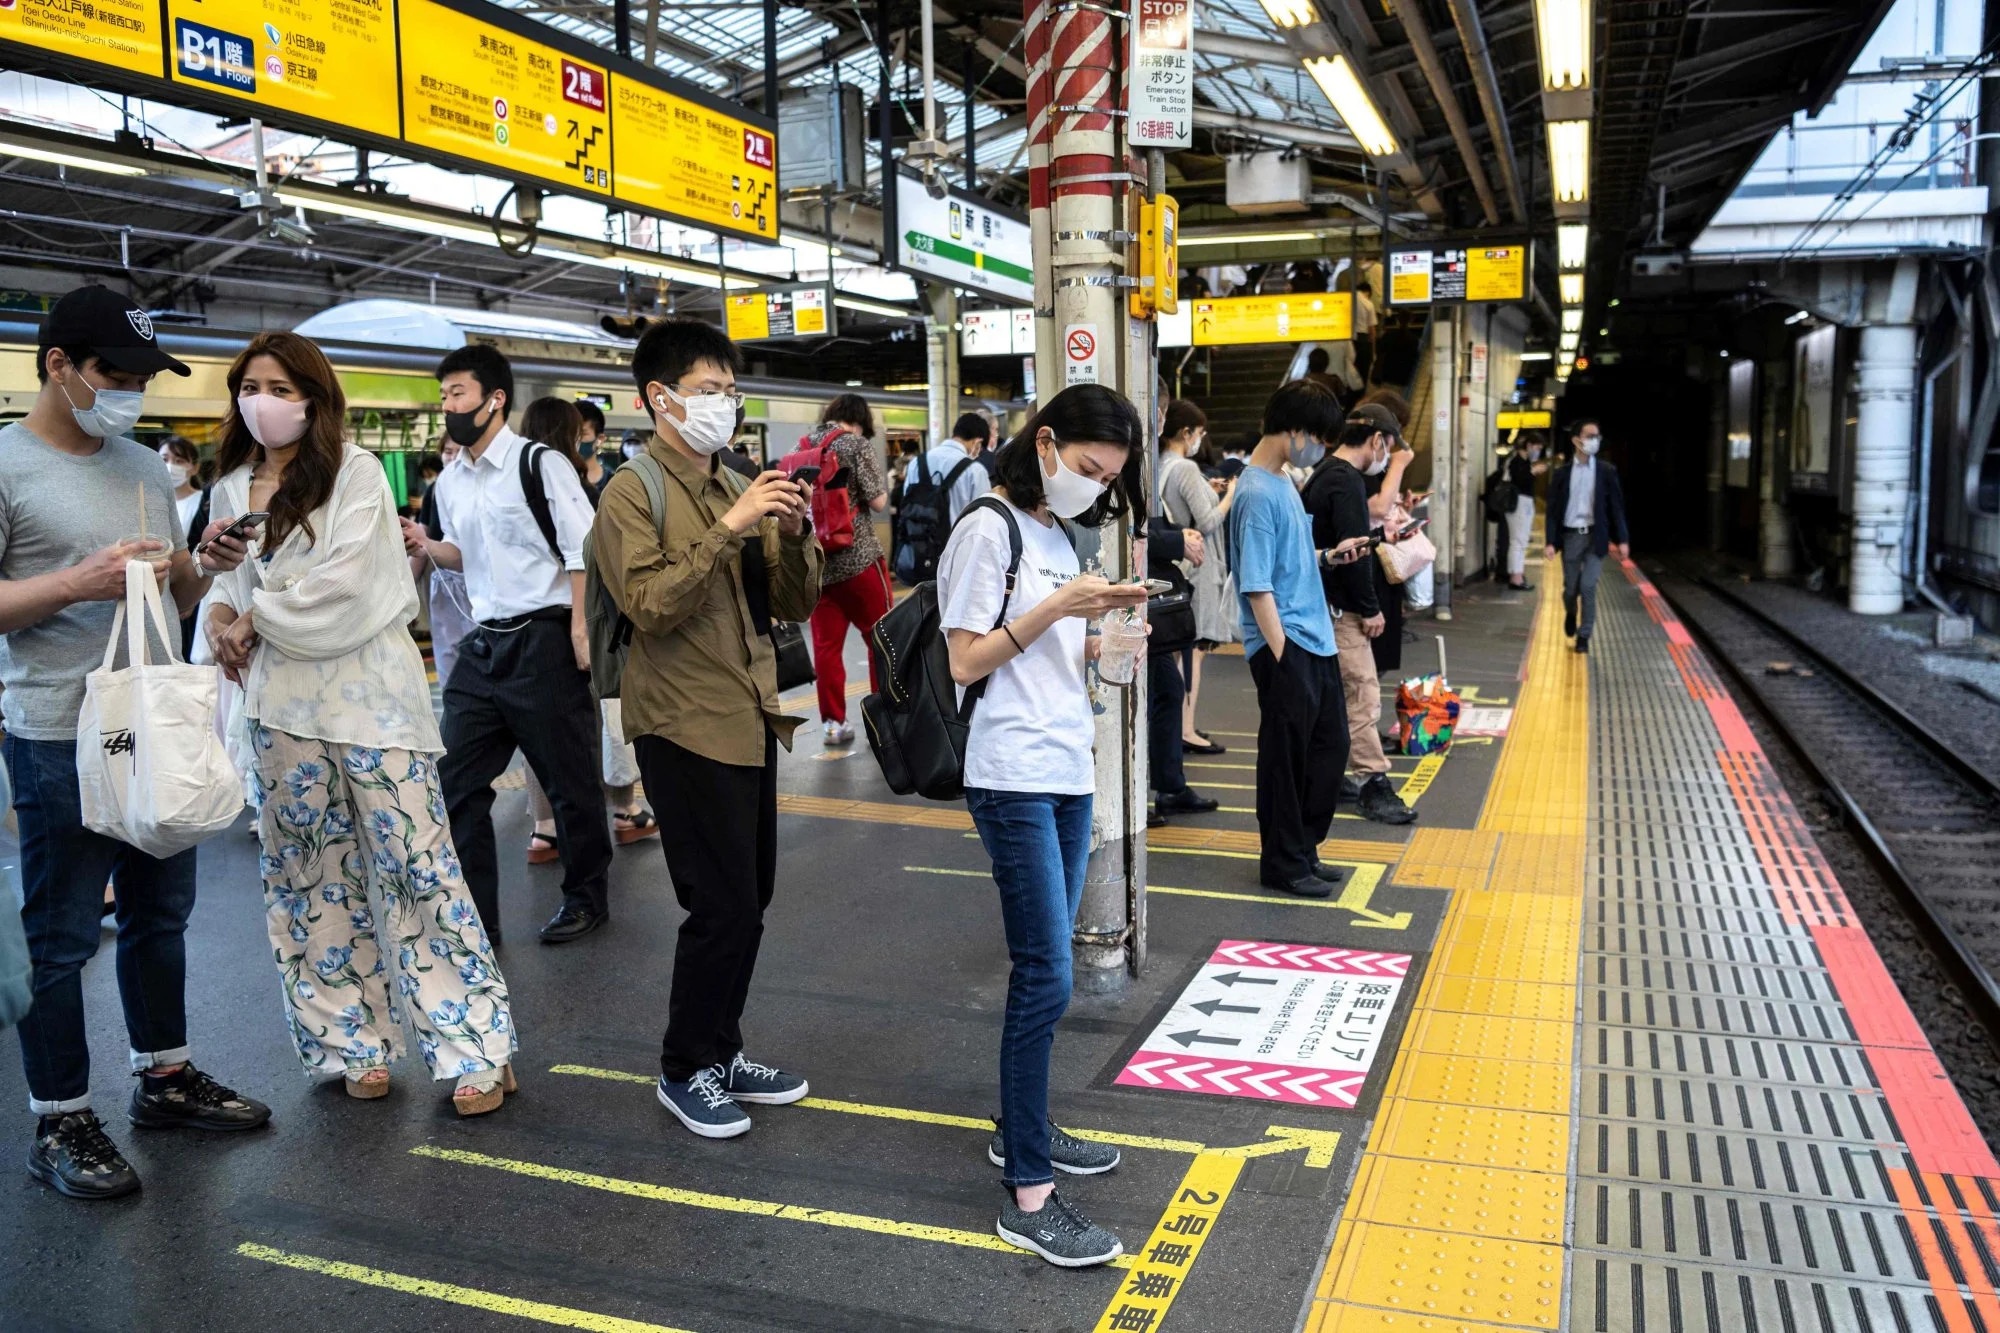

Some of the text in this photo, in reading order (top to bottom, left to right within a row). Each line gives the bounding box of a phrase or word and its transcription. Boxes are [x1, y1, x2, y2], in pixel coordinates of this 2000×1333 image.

[21, 4, 86, 29] Toei Oedo Line
[1143, 2, 1185, 15] STOP
[108, 39, 139, 55] Station)
[285, 31, 326, 55] 小田急線
[479, 34, 518, 61] 東南改札
[286, 61, 318, 82] 京王線
[528, 52, 555, 75] 南改札
[1140, 55, 1186, 69] 非常停止
[226, 69, 252, 84] Floor
[1151, 72, 1186, 84] ボタン
[1146, 86, 1186, 95] Emergency
[1148, 95, 1186, 105] Train Stop
[1161, 105, 1186, 113] Button
[1136, 120, 1174, 140] 16番線用
[1257, 977, 1315, 1055] Please leave this area
[1297, 979, 1348, 1059] この場所を空けてください
[1331, 982, 1393, 1062] 降車エリア
